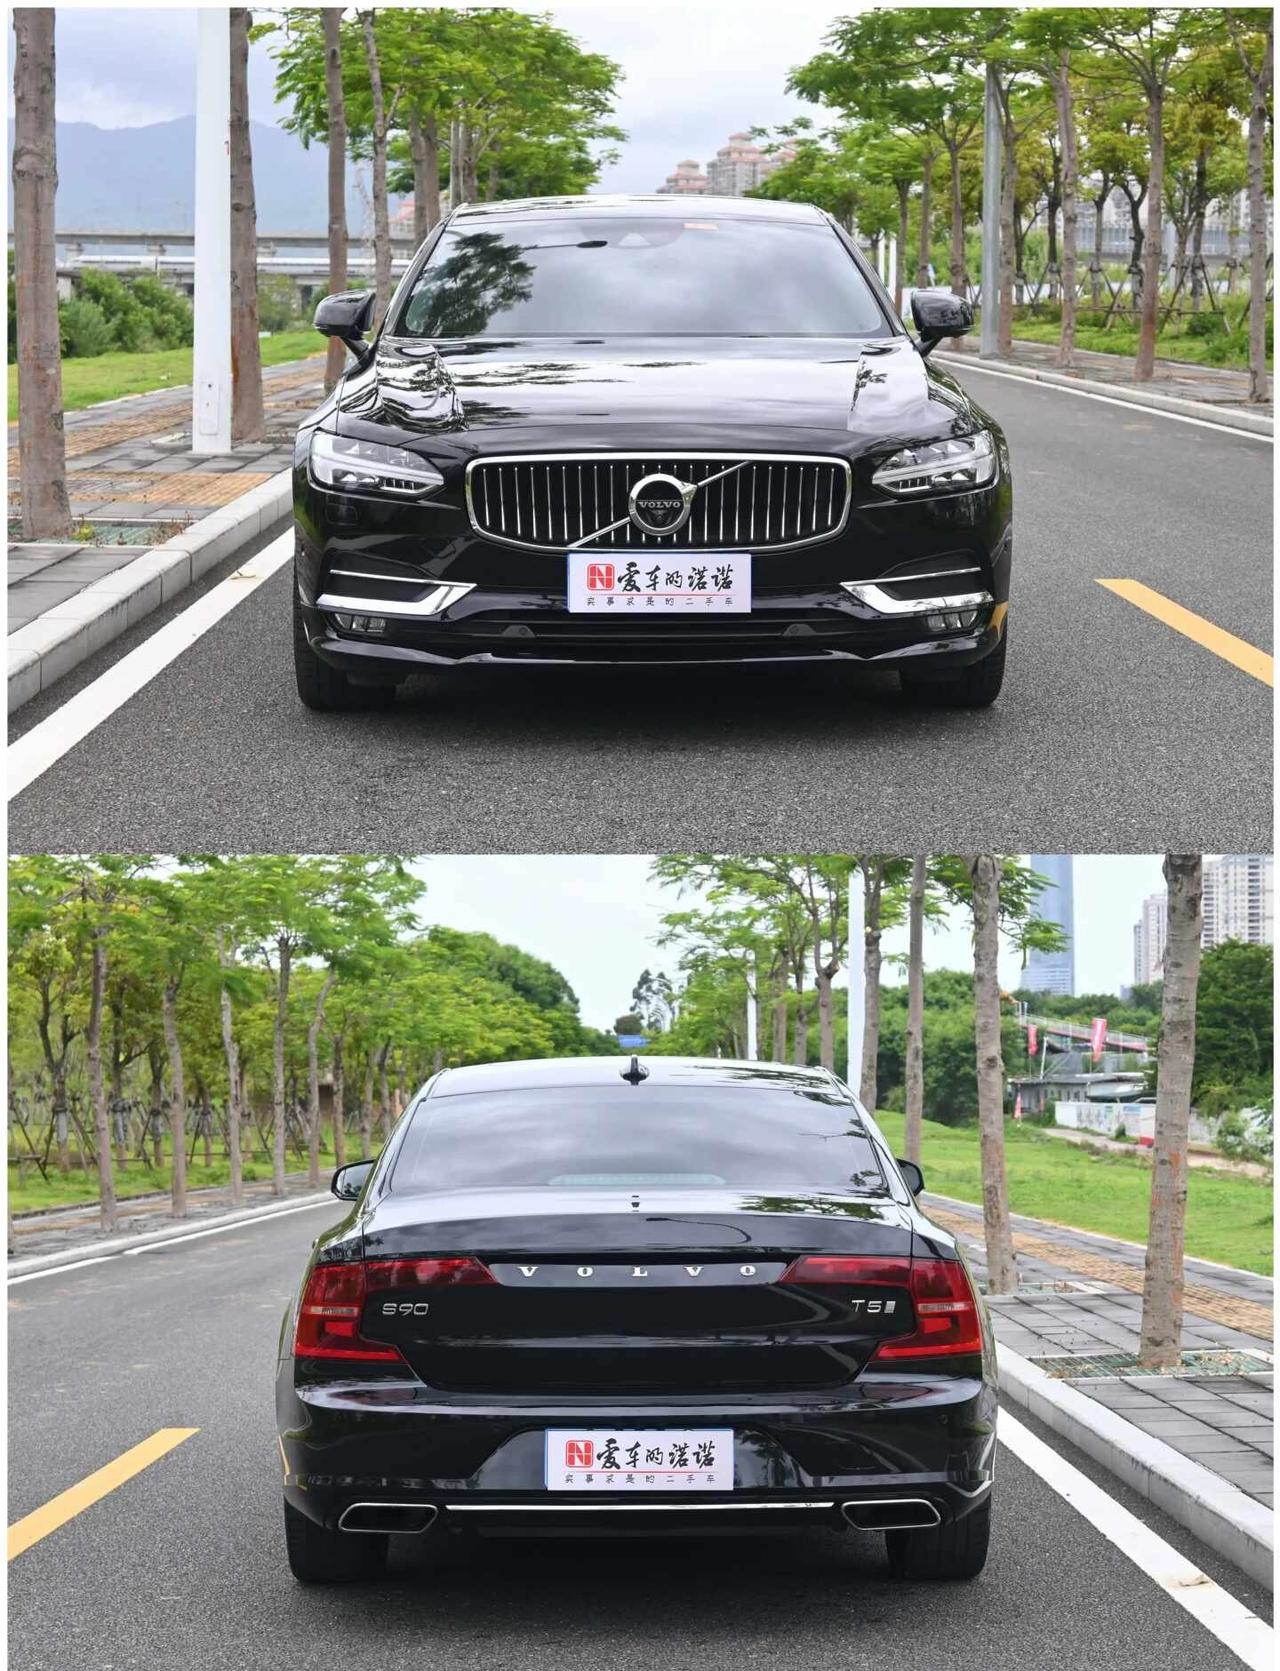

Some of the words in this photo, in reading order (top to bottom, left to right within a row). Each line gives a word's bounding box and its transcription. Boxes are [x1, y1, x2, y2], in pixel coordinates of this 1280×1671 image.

[617, 561, 734, 592] 爱车的诺诺
[586, 597, 734, 607] 实事求是的二手车
[518, 1265, 757, 1278] VOLVO
[382, 1303, 429, 1316] S90
[851, 1299, 882, 1313] T5
[596, 1438, 716, 1470] 爱车的诺诺
[564, 1474, 716, 1484] 实事求是的二手车
